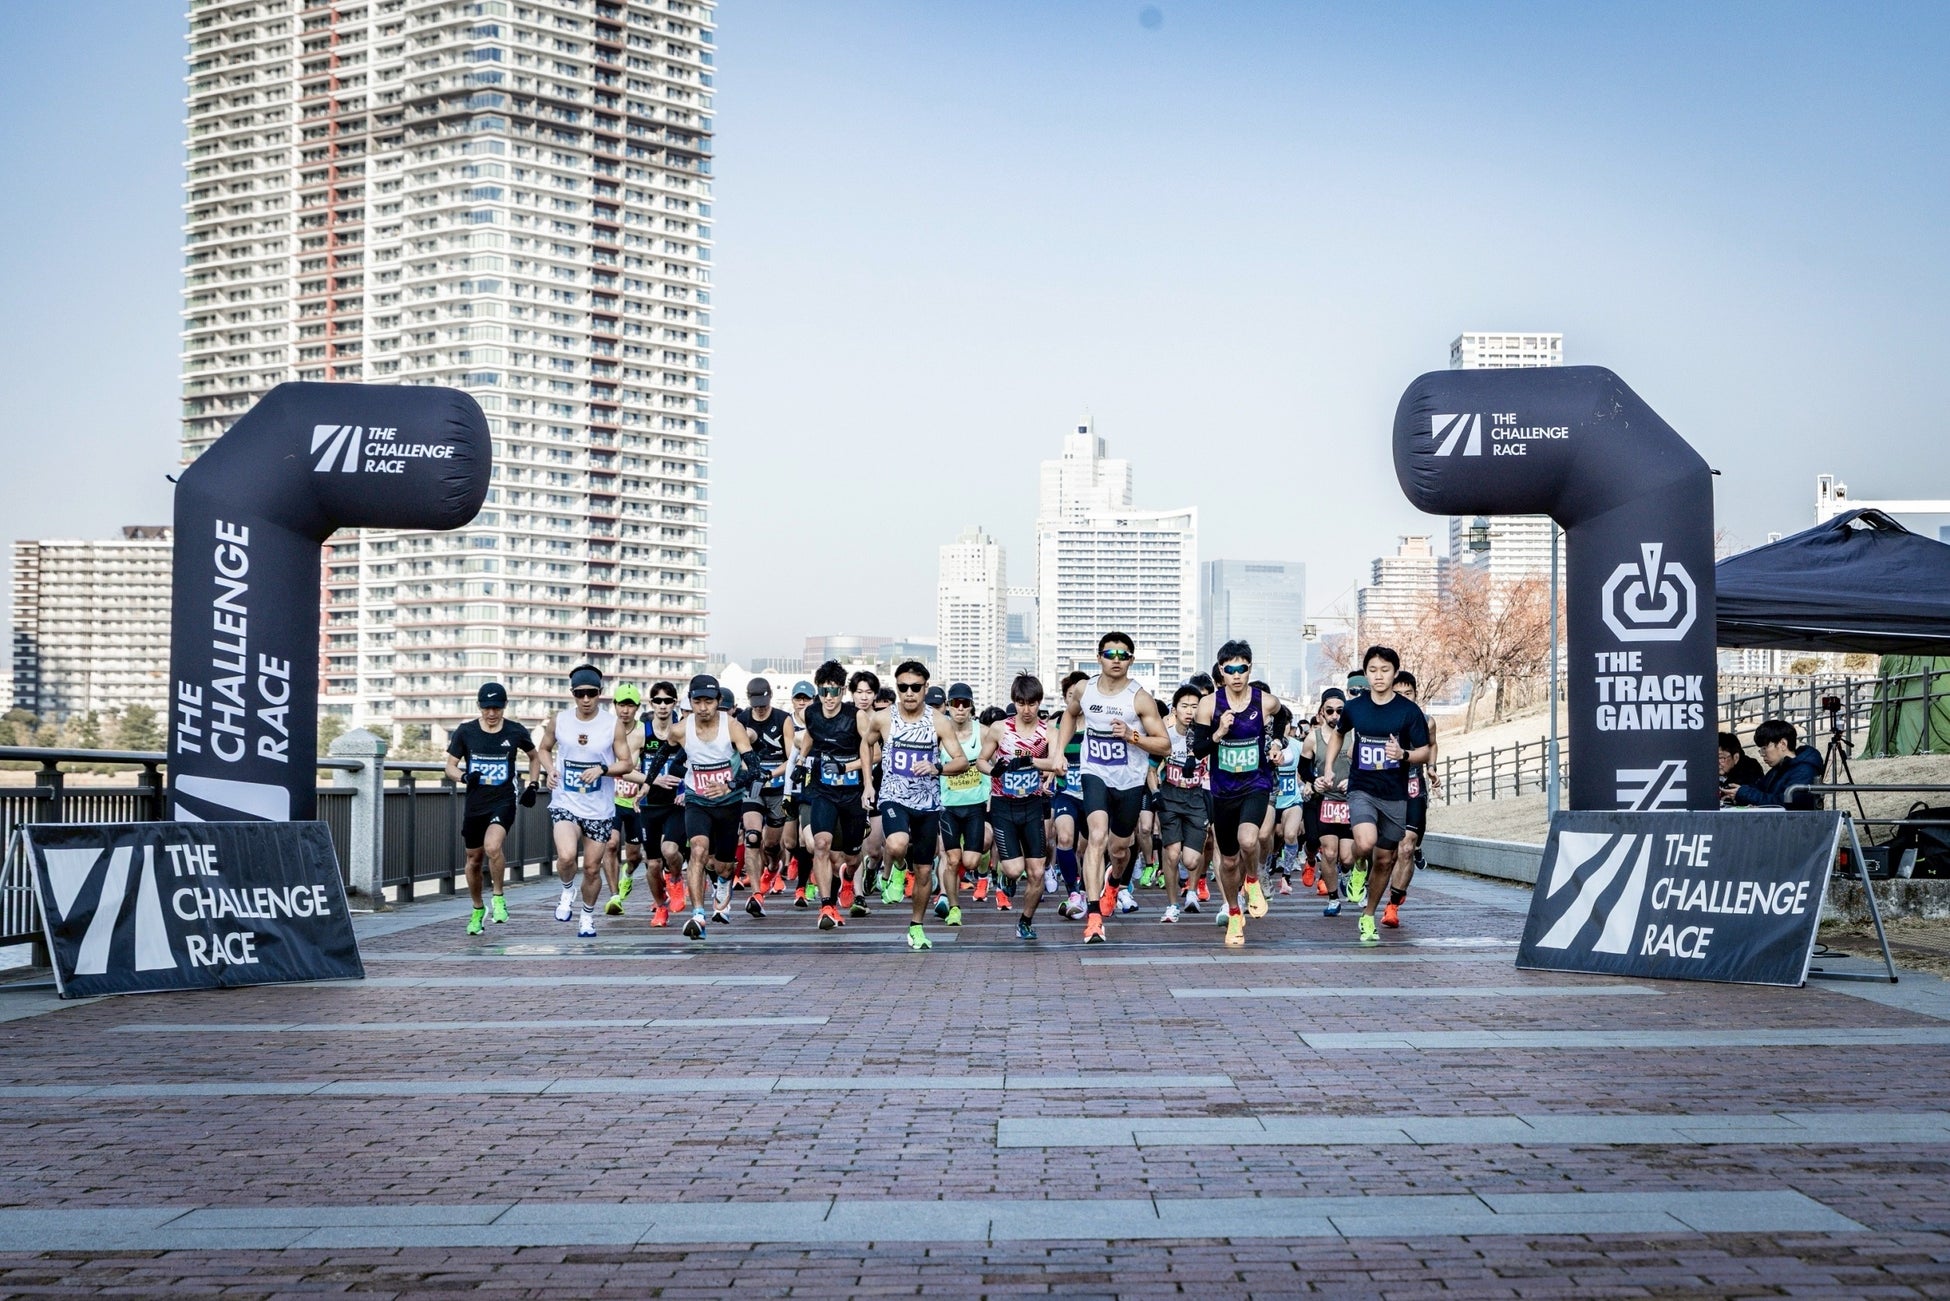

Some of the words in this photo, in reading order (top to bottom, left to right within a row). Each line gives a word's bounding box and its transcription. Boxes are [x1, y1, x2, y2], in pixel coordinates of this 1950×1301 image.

[1492, 412, 1517, 425] THE
[368, 427, 397, 441] THE
[1491, 426, 1569, 441] CHALLENGE
[364, 443, 455, 461] CHALLENGE
[1492, 443, 1527, 456] RACE
[364, 459, 406, 474] RACE
[210, 519, 250, 763] CHALLENGE
[1594, 650, 1643, 673] THE
[1594, 674, 1704, 703] TRACK
[177, 680, 203, 754] THE
[257, 652, 290, 764] RACE
[1596, 703, 1705, 732] GAMES
[1089, 739, 1126, 760] 903
[1222, 748, 1257, 767] 1048
[1361, 746, 1398, 765] 90
[1004, 771, 1039, 790] 5232
[165, 843, 219, 877] THE
[1665, 833, 1713, 867] THE
[172, 884, 331, 921] CHALLENGE
[1652, 877, 1810, 915] CHALLENGE
[185, 931, 260, 968] RACE
[1640, 923, 1714, 959] RACE
